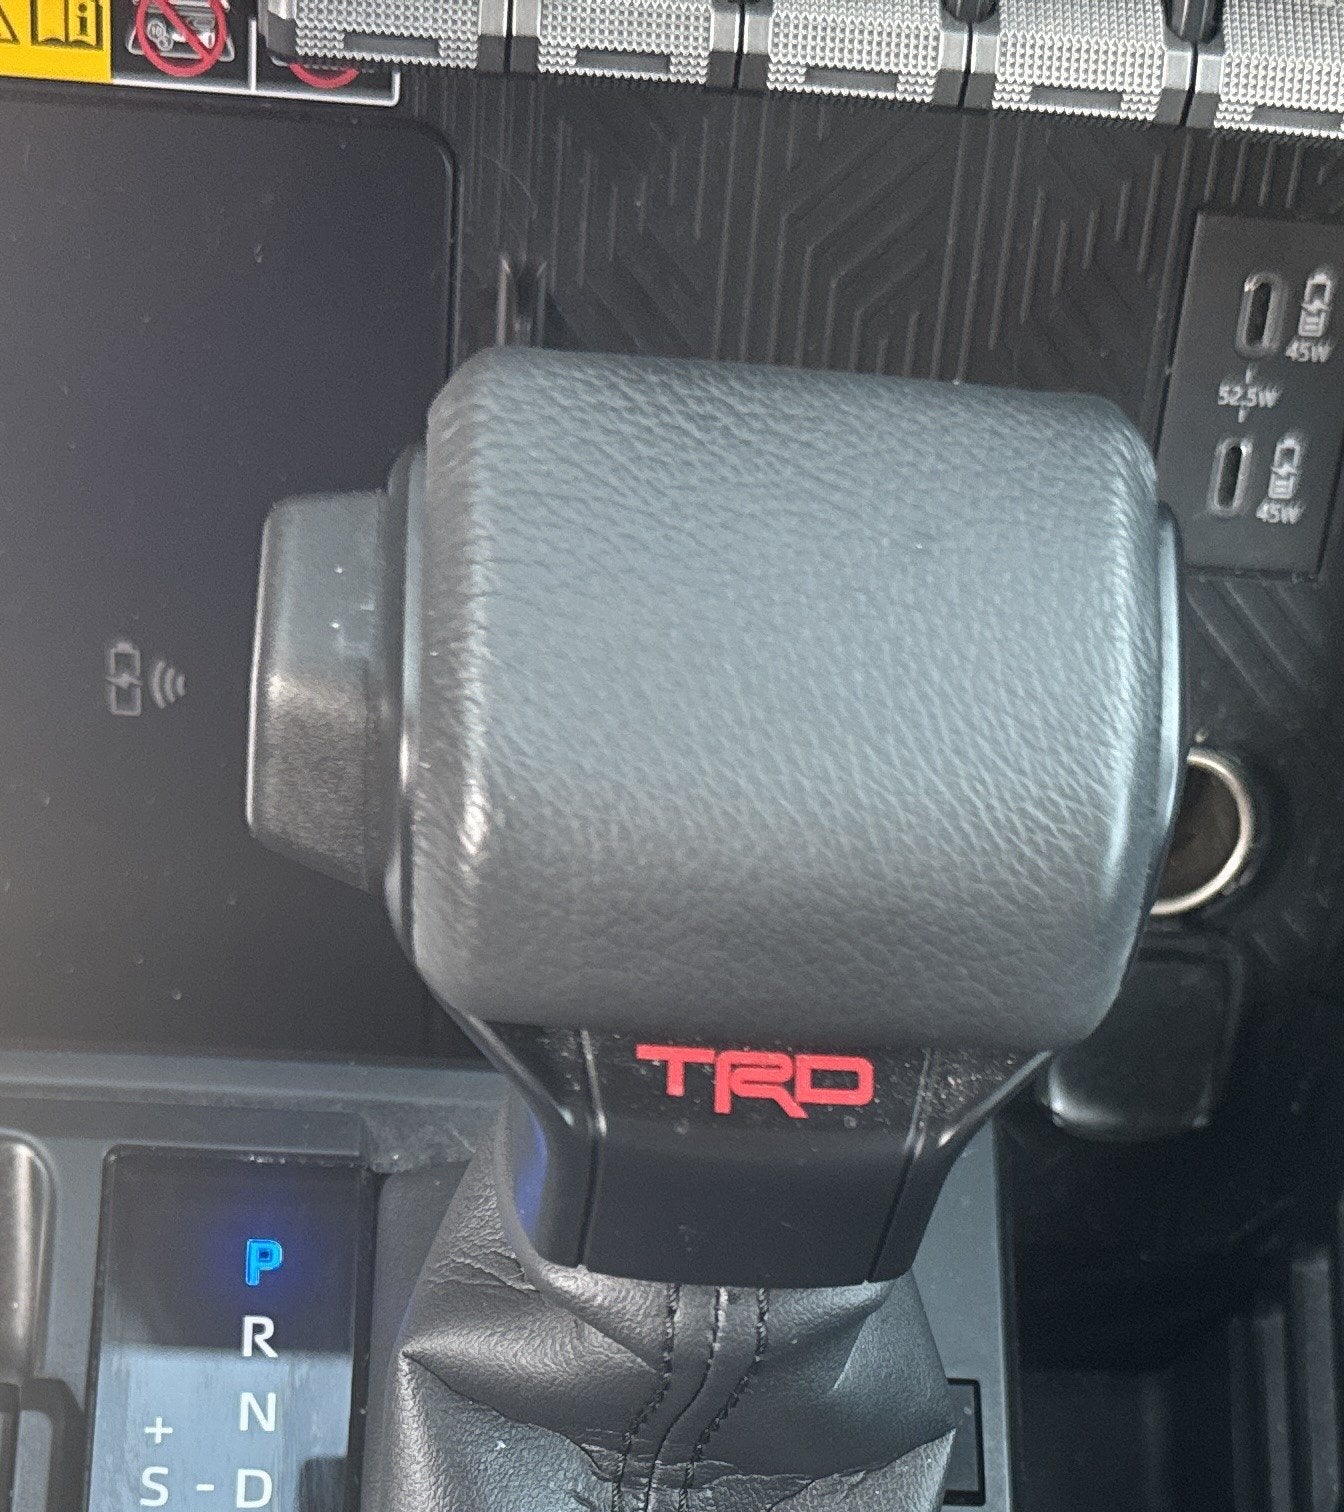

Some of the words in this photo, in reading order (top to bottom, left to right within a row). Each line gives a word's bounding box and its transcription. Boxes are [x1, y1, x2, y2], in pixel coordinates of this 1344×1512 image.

[1285, 339, 1333, 363] 45W
[1256, 501, 1304, 525] 45W
[635, 1043, 875, 1119] TRD
[244, 1237, 285, 1288] P
[240, 1314, 278, 1359] R
[239, 1390, 277, 1433] N
[139, 1466, 171, 1508] S
[234, 1467, 274, 1510] D
